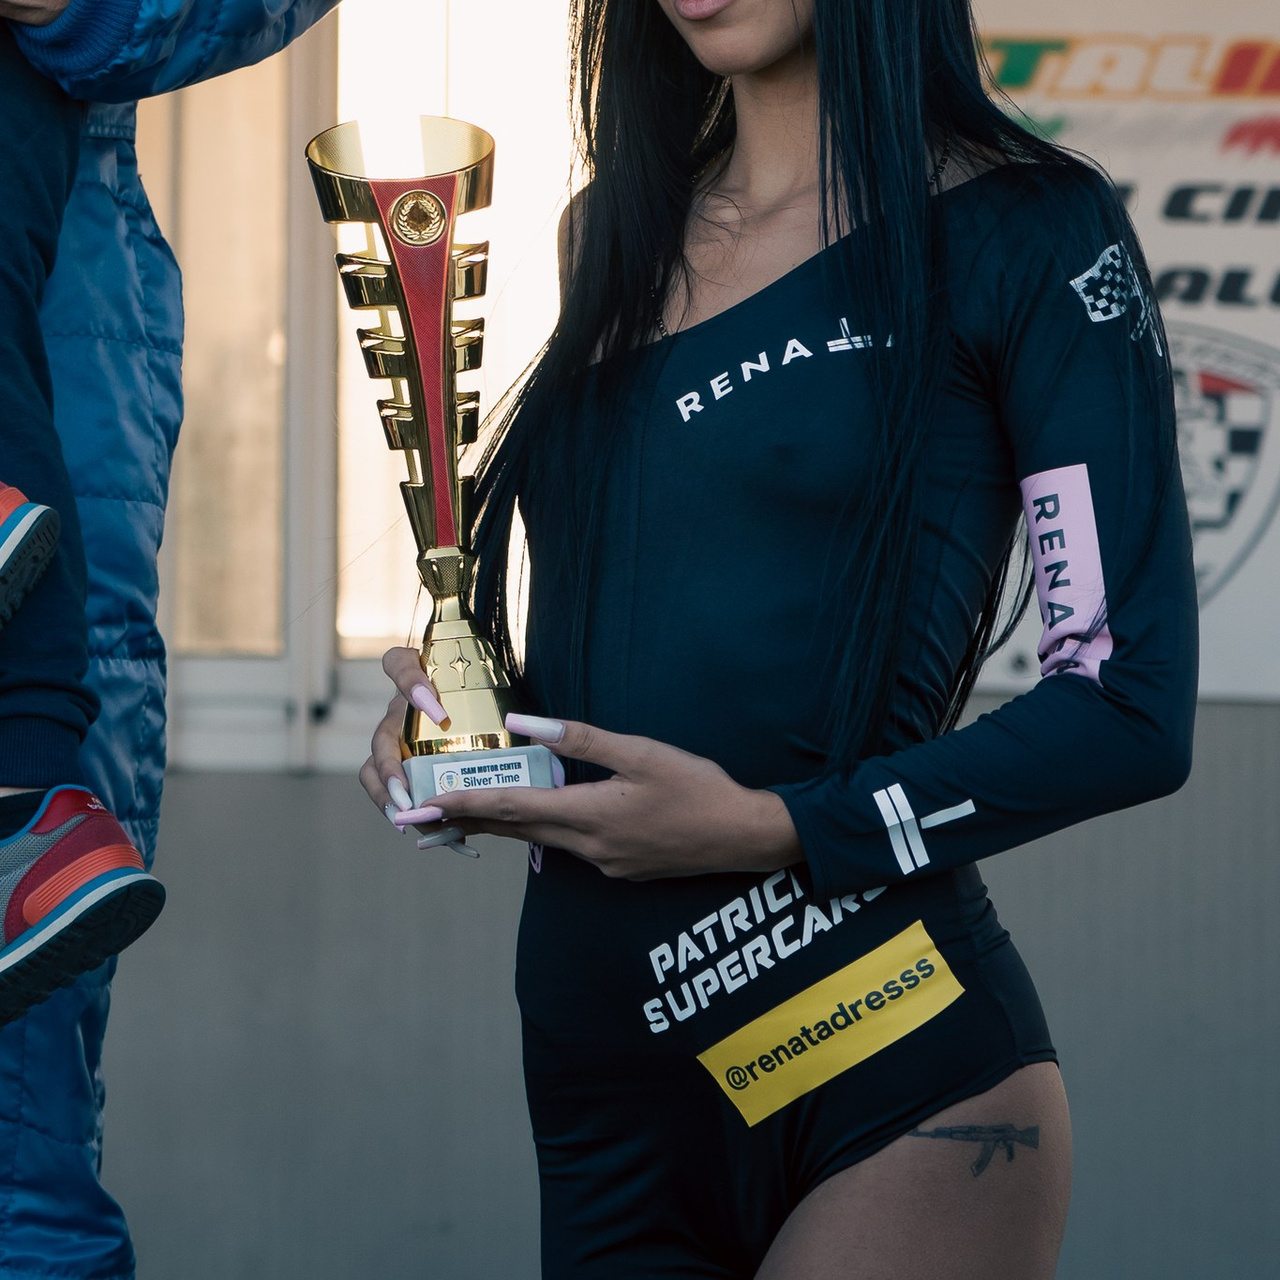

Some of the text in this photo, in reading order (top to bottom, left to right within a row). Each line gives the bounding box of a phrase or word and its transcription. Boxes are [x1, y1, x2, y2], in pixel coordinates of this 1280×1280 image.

[461, 761, 522, 776] ISAM MOTOR CENTER
[463, 776, 492, 788] Silver
[496, 772, 520, 784] Time
[725, 957, 935, 1090] @renatadresss
